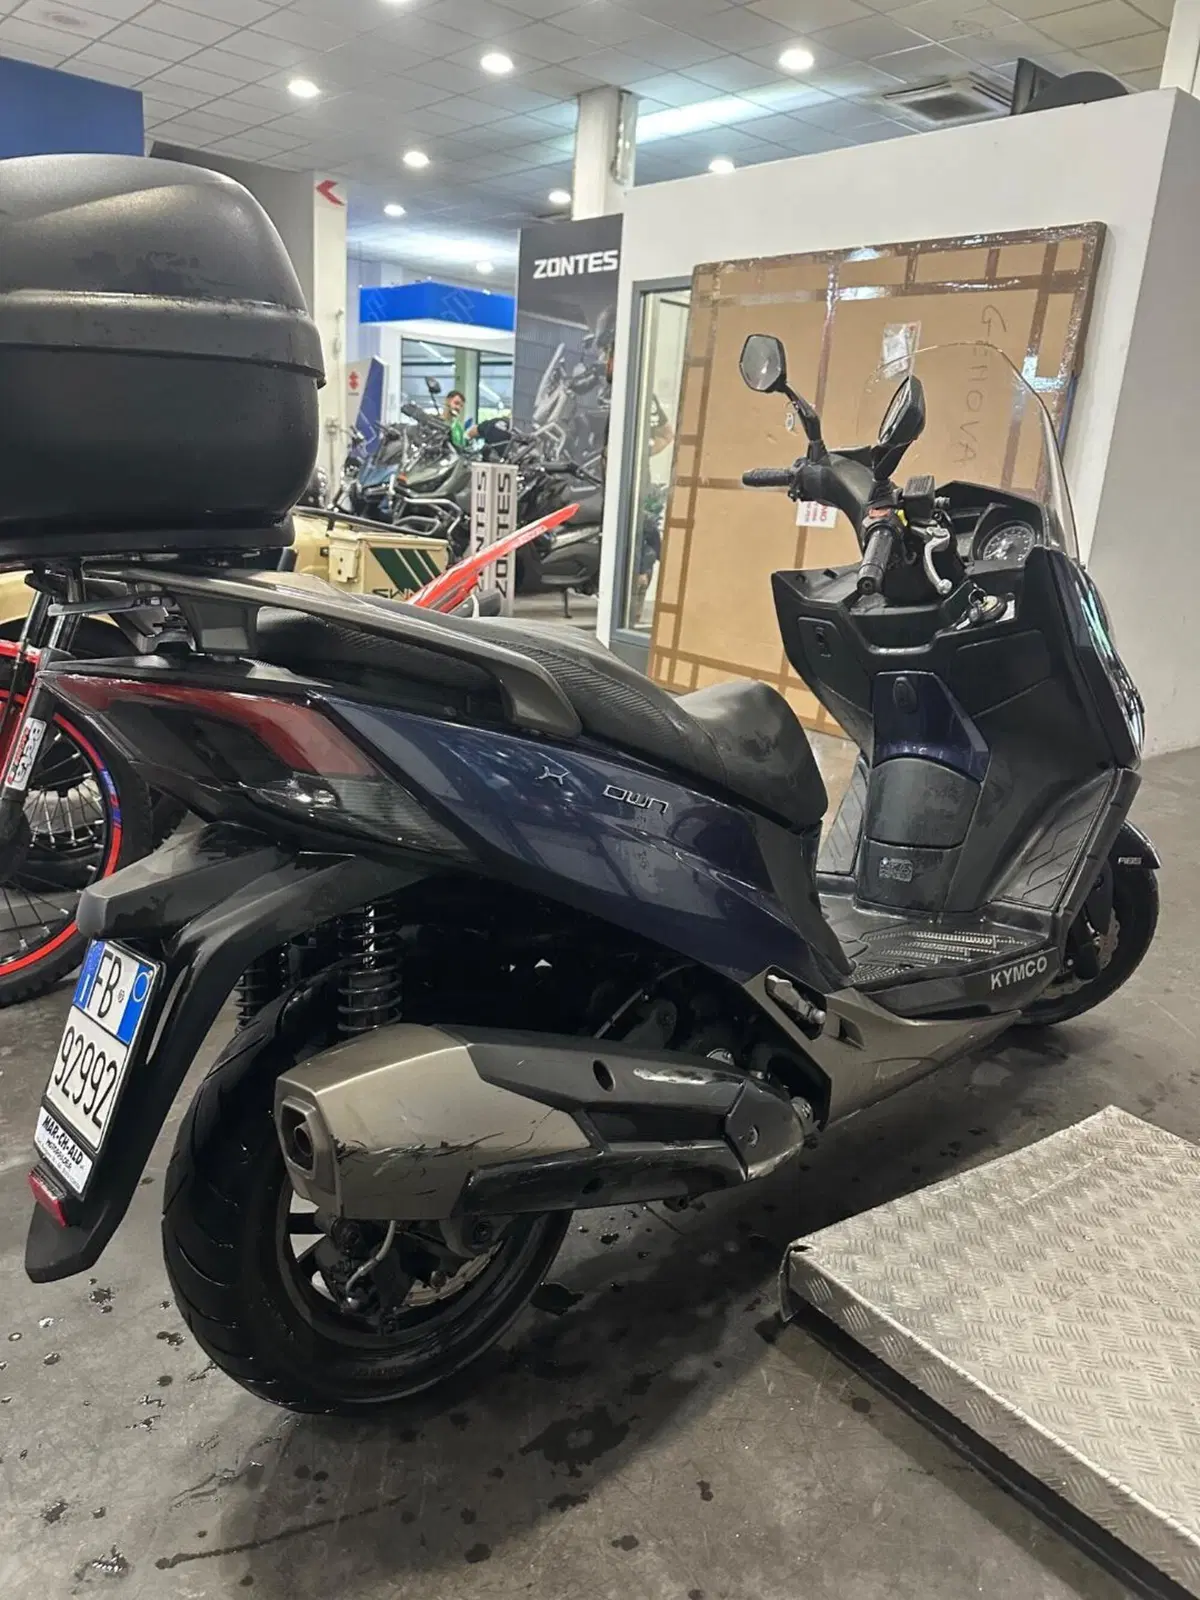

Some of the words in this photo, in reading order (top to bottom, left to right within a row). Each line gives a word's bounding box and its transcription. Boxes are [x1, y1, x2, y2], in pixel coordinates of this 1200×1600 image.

[532, 249, 619, 279] ZONTES
[496, 472, 511, 599] ZOTES
[86, 949, 123, 1019] FB
[990, 955, 1048, 990] KYMCO
[54, 1025, 118, 1129] 92992
